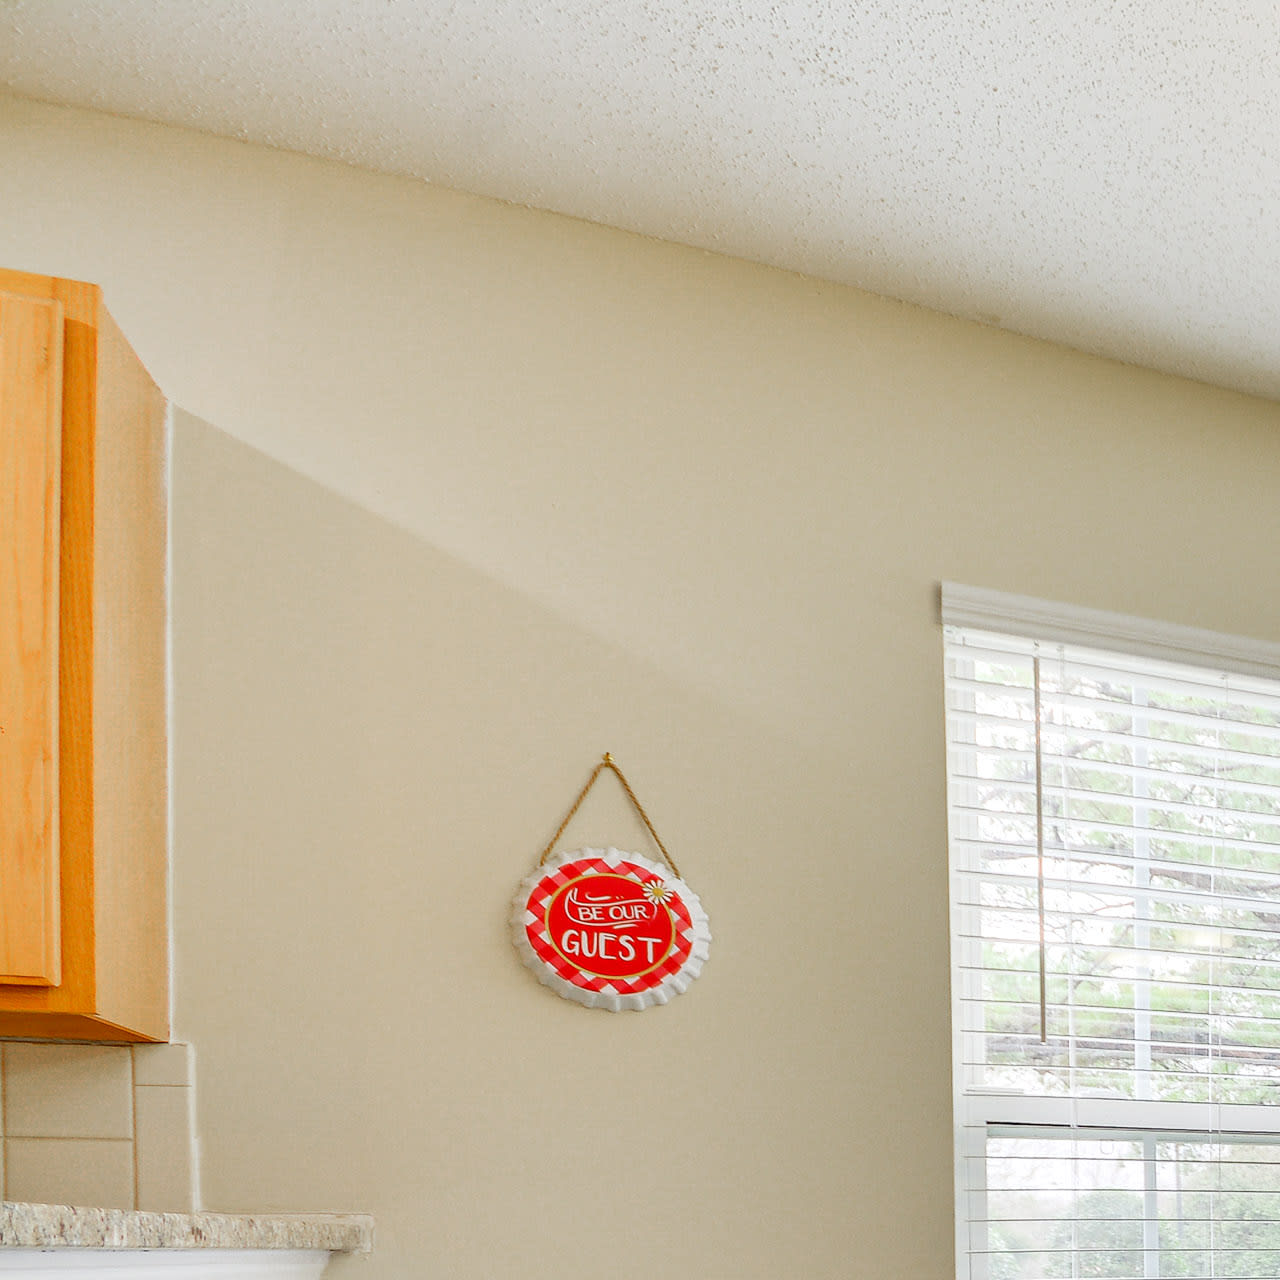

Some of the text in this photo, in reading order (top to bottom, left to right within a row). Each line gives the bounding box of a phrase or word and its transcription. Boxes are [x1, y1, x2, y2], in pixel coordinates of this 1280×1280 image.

[578, 904, 650, 921] BE OUR
[561, 929, 662, 963] GUEST
